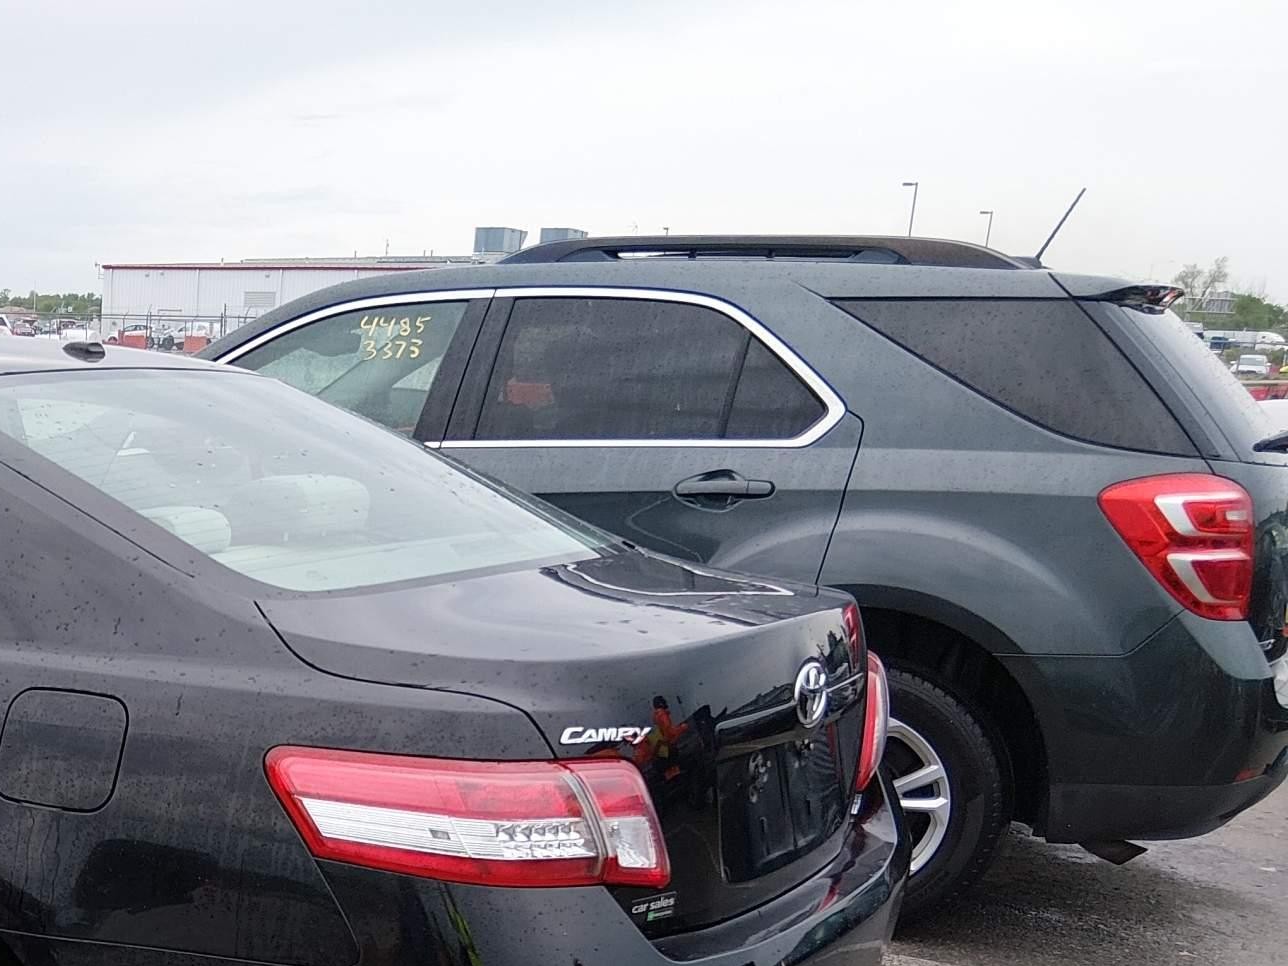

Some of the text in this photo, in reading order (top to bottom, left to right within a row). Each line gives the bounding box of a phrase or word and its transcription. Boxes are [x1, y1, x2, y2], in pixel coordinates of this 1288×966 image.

[360, 315, 432, 337] 4485
[560, 726, 652, 745] CAMRY
[631, 897, 675, 914] car sales
